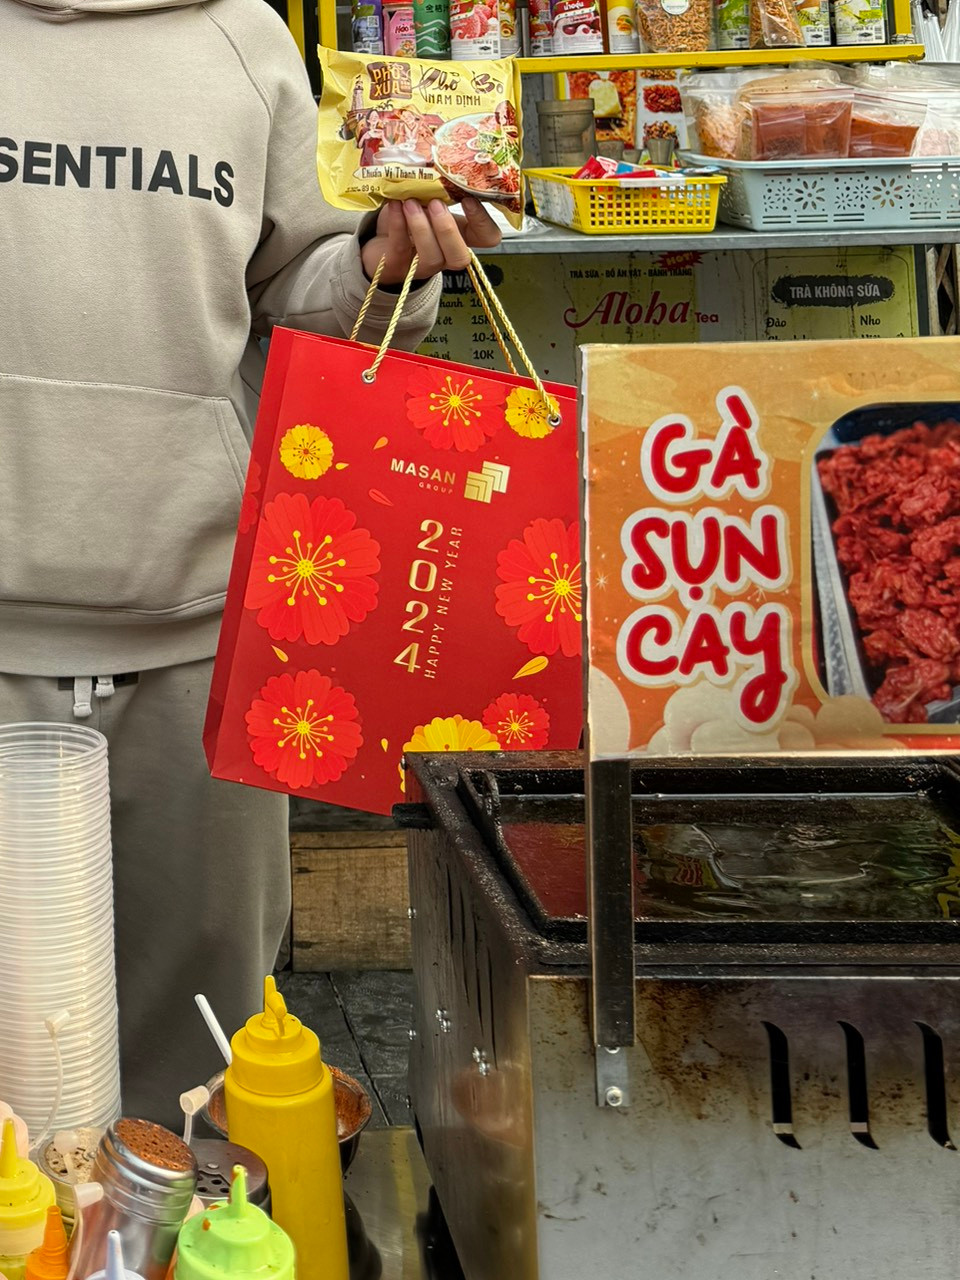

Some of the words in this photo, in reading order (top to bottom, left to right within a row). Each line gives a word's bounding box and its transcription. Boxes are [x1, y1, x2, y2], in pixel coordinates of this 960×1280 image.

[428, 94, 452, 106] NAM
[456, 95, 481, 108] ĐỊNH
[418, 168, 434, 181] Nam
[790, 284, 812, 299] TRÀ
[815, 283, 854, 298] KHÔNG
[857, 282, 881, 297] SỮA
[440, 298, 463, 308] hanh
[563, 291, 691, 329] Aloha
[695, 312, 719, 323] Tea
[766, 317, 787, 328] Đào
[860, 315, 881, 326] Nho
[473, 350, 494, 361] 10K
[646, 390, 765, 497] GÀ
[390, 457, 456, 485] MASAN
[418, 481, 453, 495] GROUP
[444, 526, 463, 570] YEAR
[626, 510, 785, 605] SỤN
[436, 578, 454, 616] NEW
[424, 623, 445, 679] HAPPY
